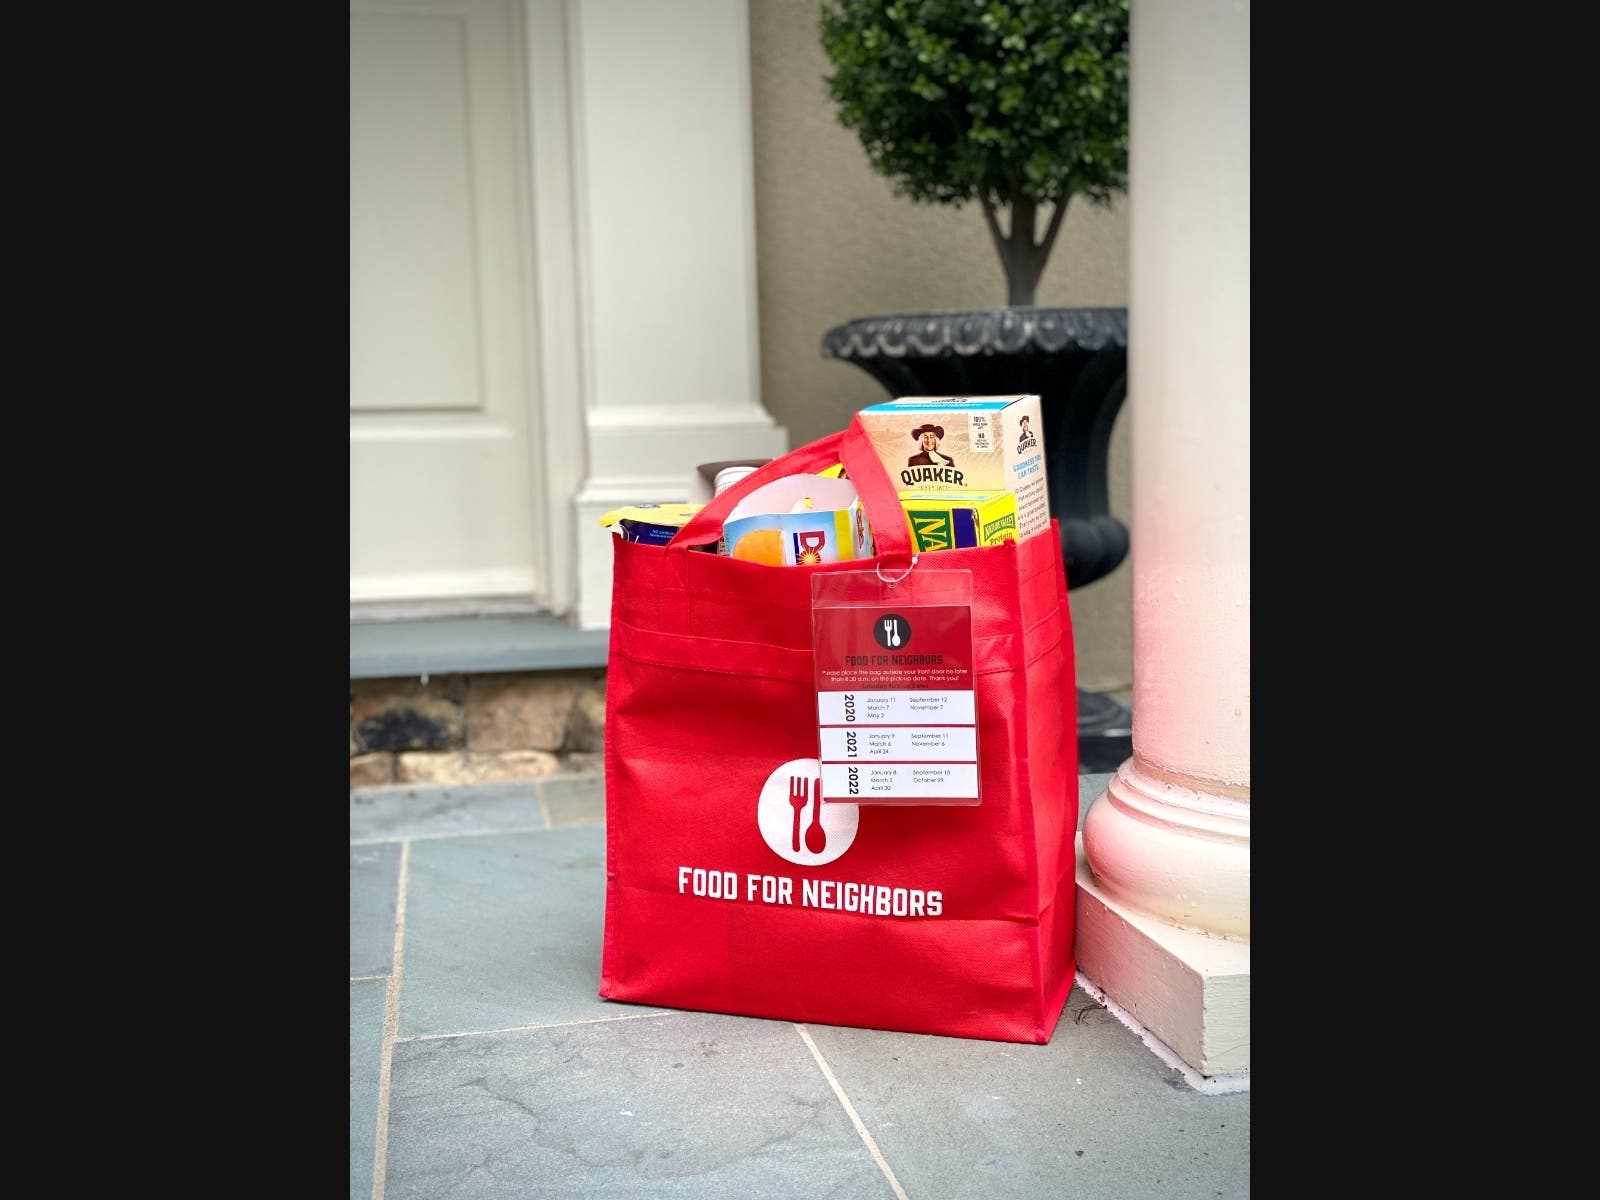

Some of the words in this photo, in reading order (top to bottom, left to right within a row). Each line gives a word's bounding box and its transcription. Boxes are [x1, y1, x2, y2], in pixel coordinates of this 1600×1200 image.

[1016, 438, 1037, 455] QUAKER
[901, 467, 964, 486] QUAKER
[845, 655, 869, 666] FOOD
[871, 655, 889, 666] FOR
[892, 654, 944, 665] NEIGHBORS
[869, 669, 882, 677] bag
[844, 694, 856, 722] 2020
[846, 731, 858, 758] 2021
[869, 731, 891, 739] January
[848, 767, 859, 795] 2022
[678, 866, 738, 900] FOOD
[747, 873, 793, 905] FOR
[802, 878, 943, 917] NEIGHBORS
